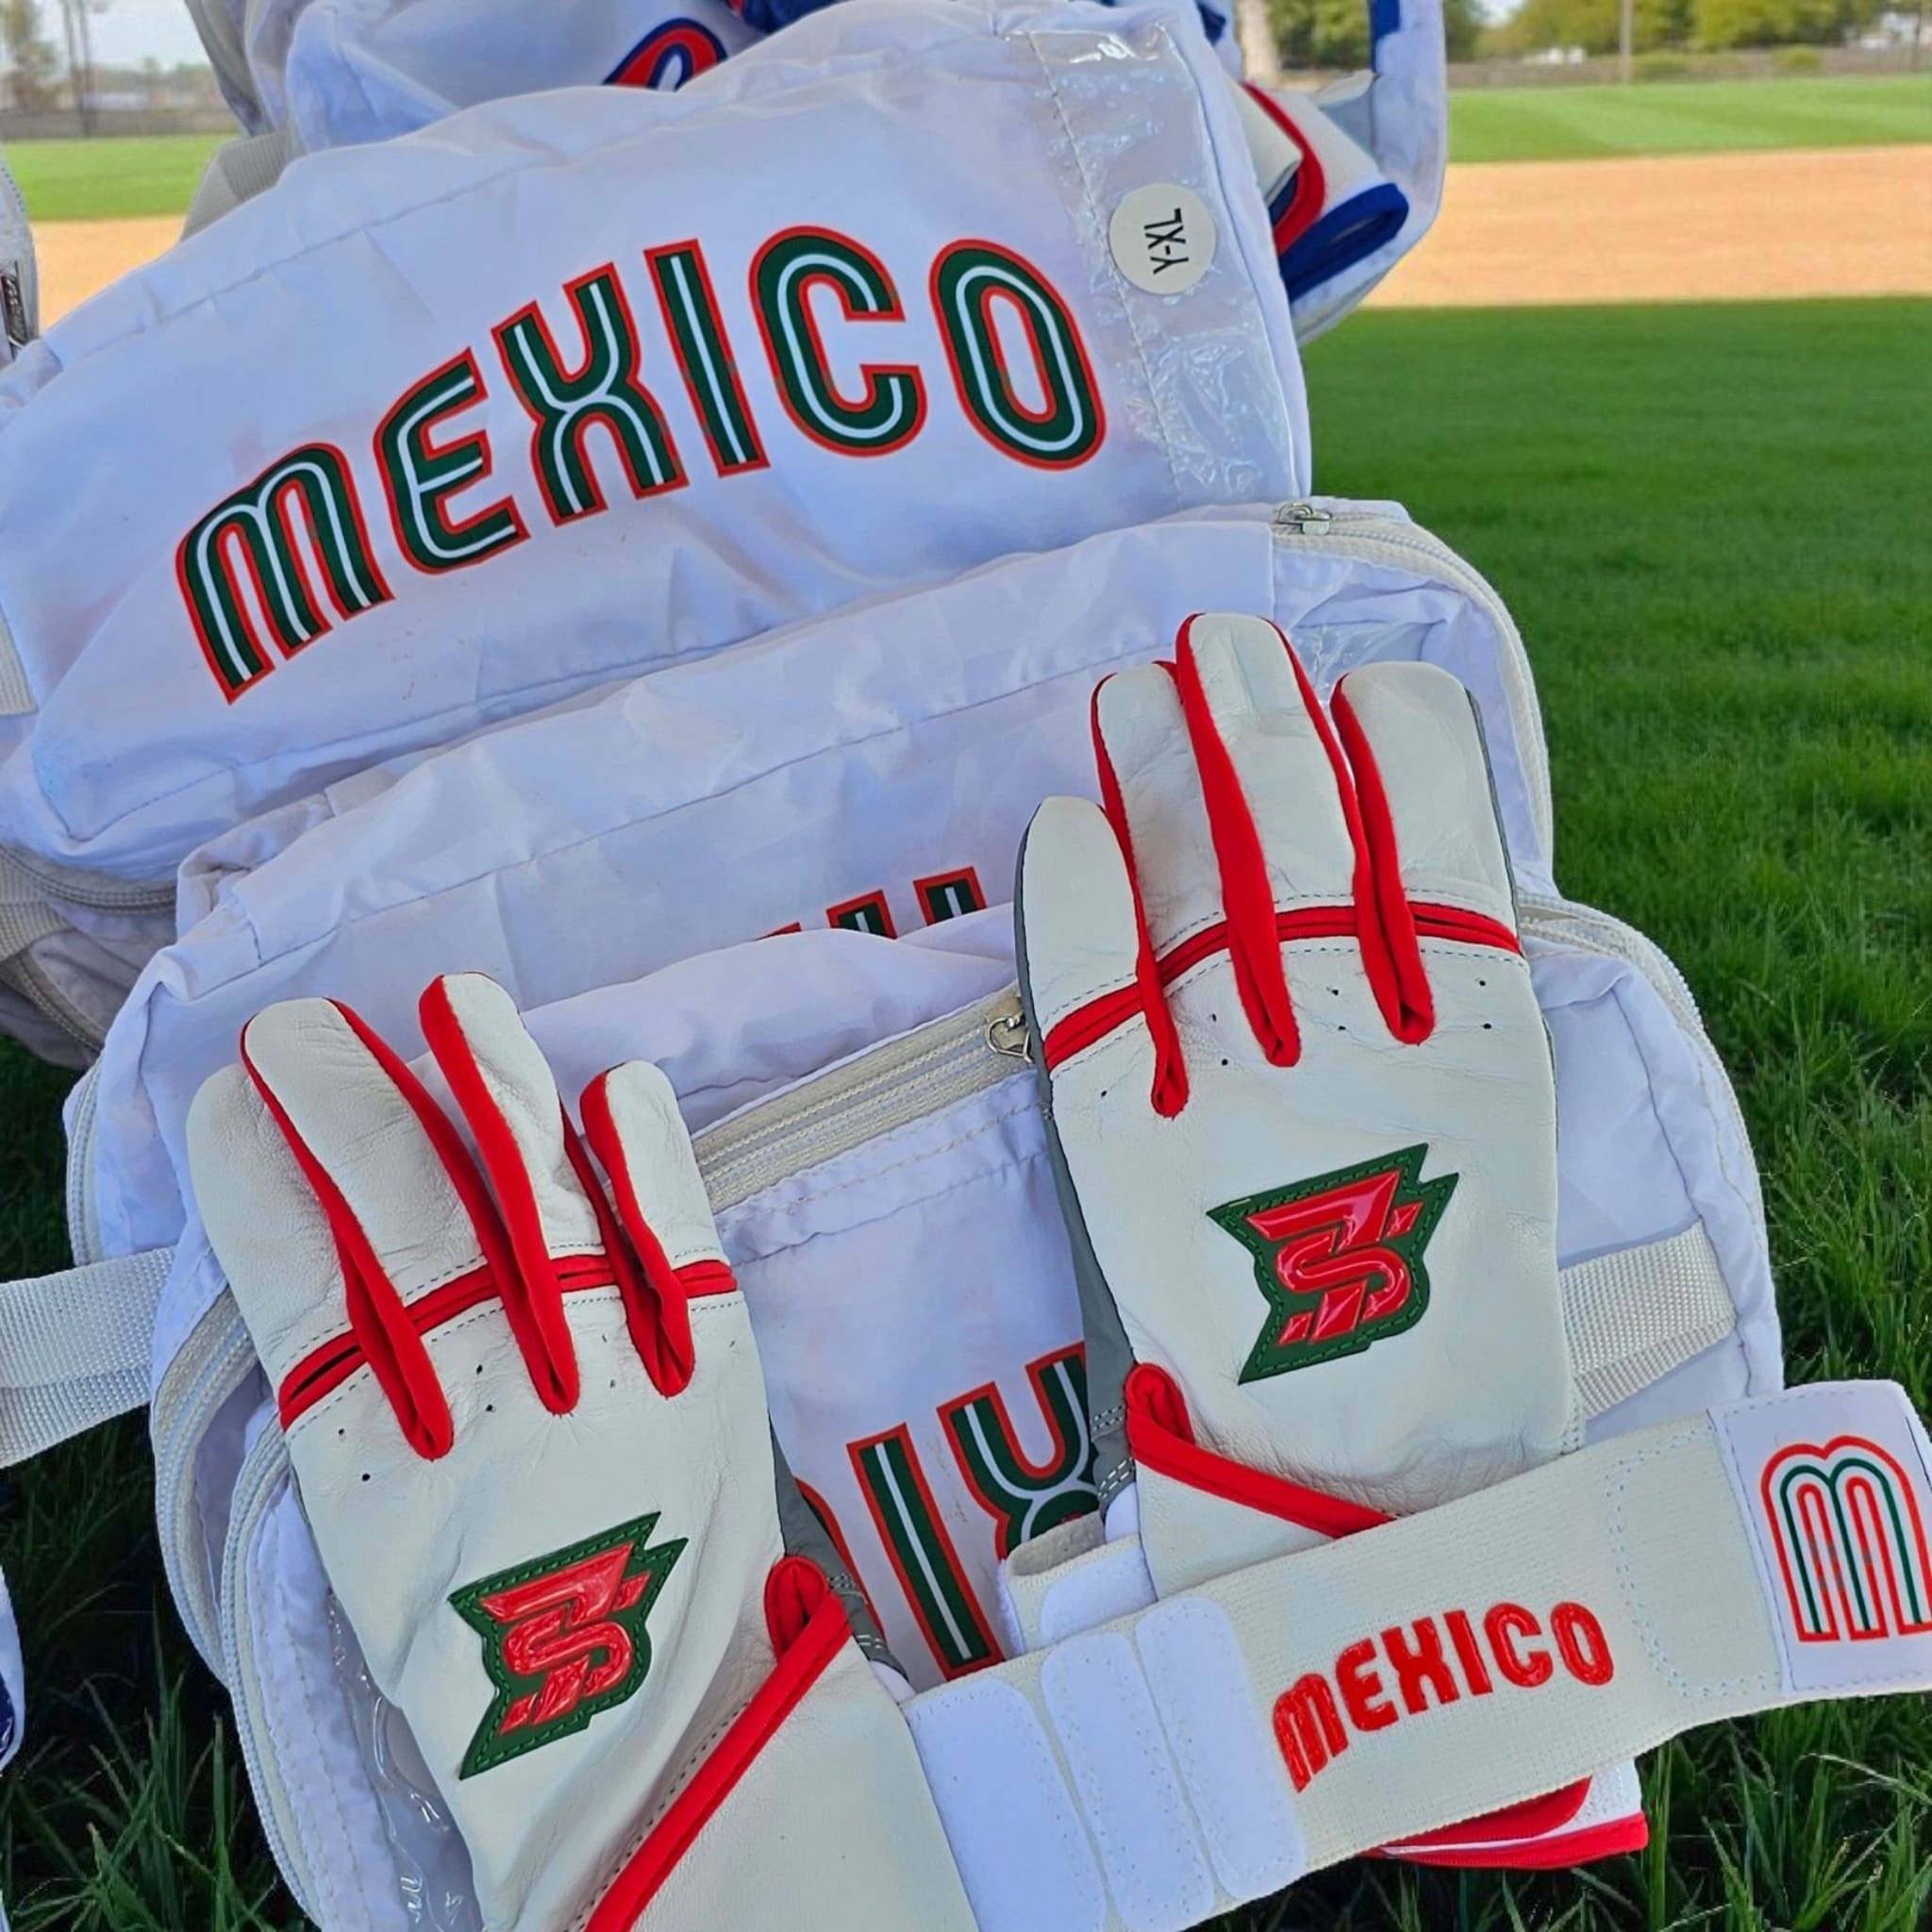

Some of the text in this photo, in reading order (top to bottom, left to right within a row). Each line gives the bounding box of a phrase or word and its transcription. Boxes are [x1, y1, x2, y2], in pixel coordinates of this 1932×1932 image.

[1143, 207, 1190, 275] Y-XL
[175, 225, 1108, 704] MEXICO
[1273, 1601, 1615, 1793] MEXICO
